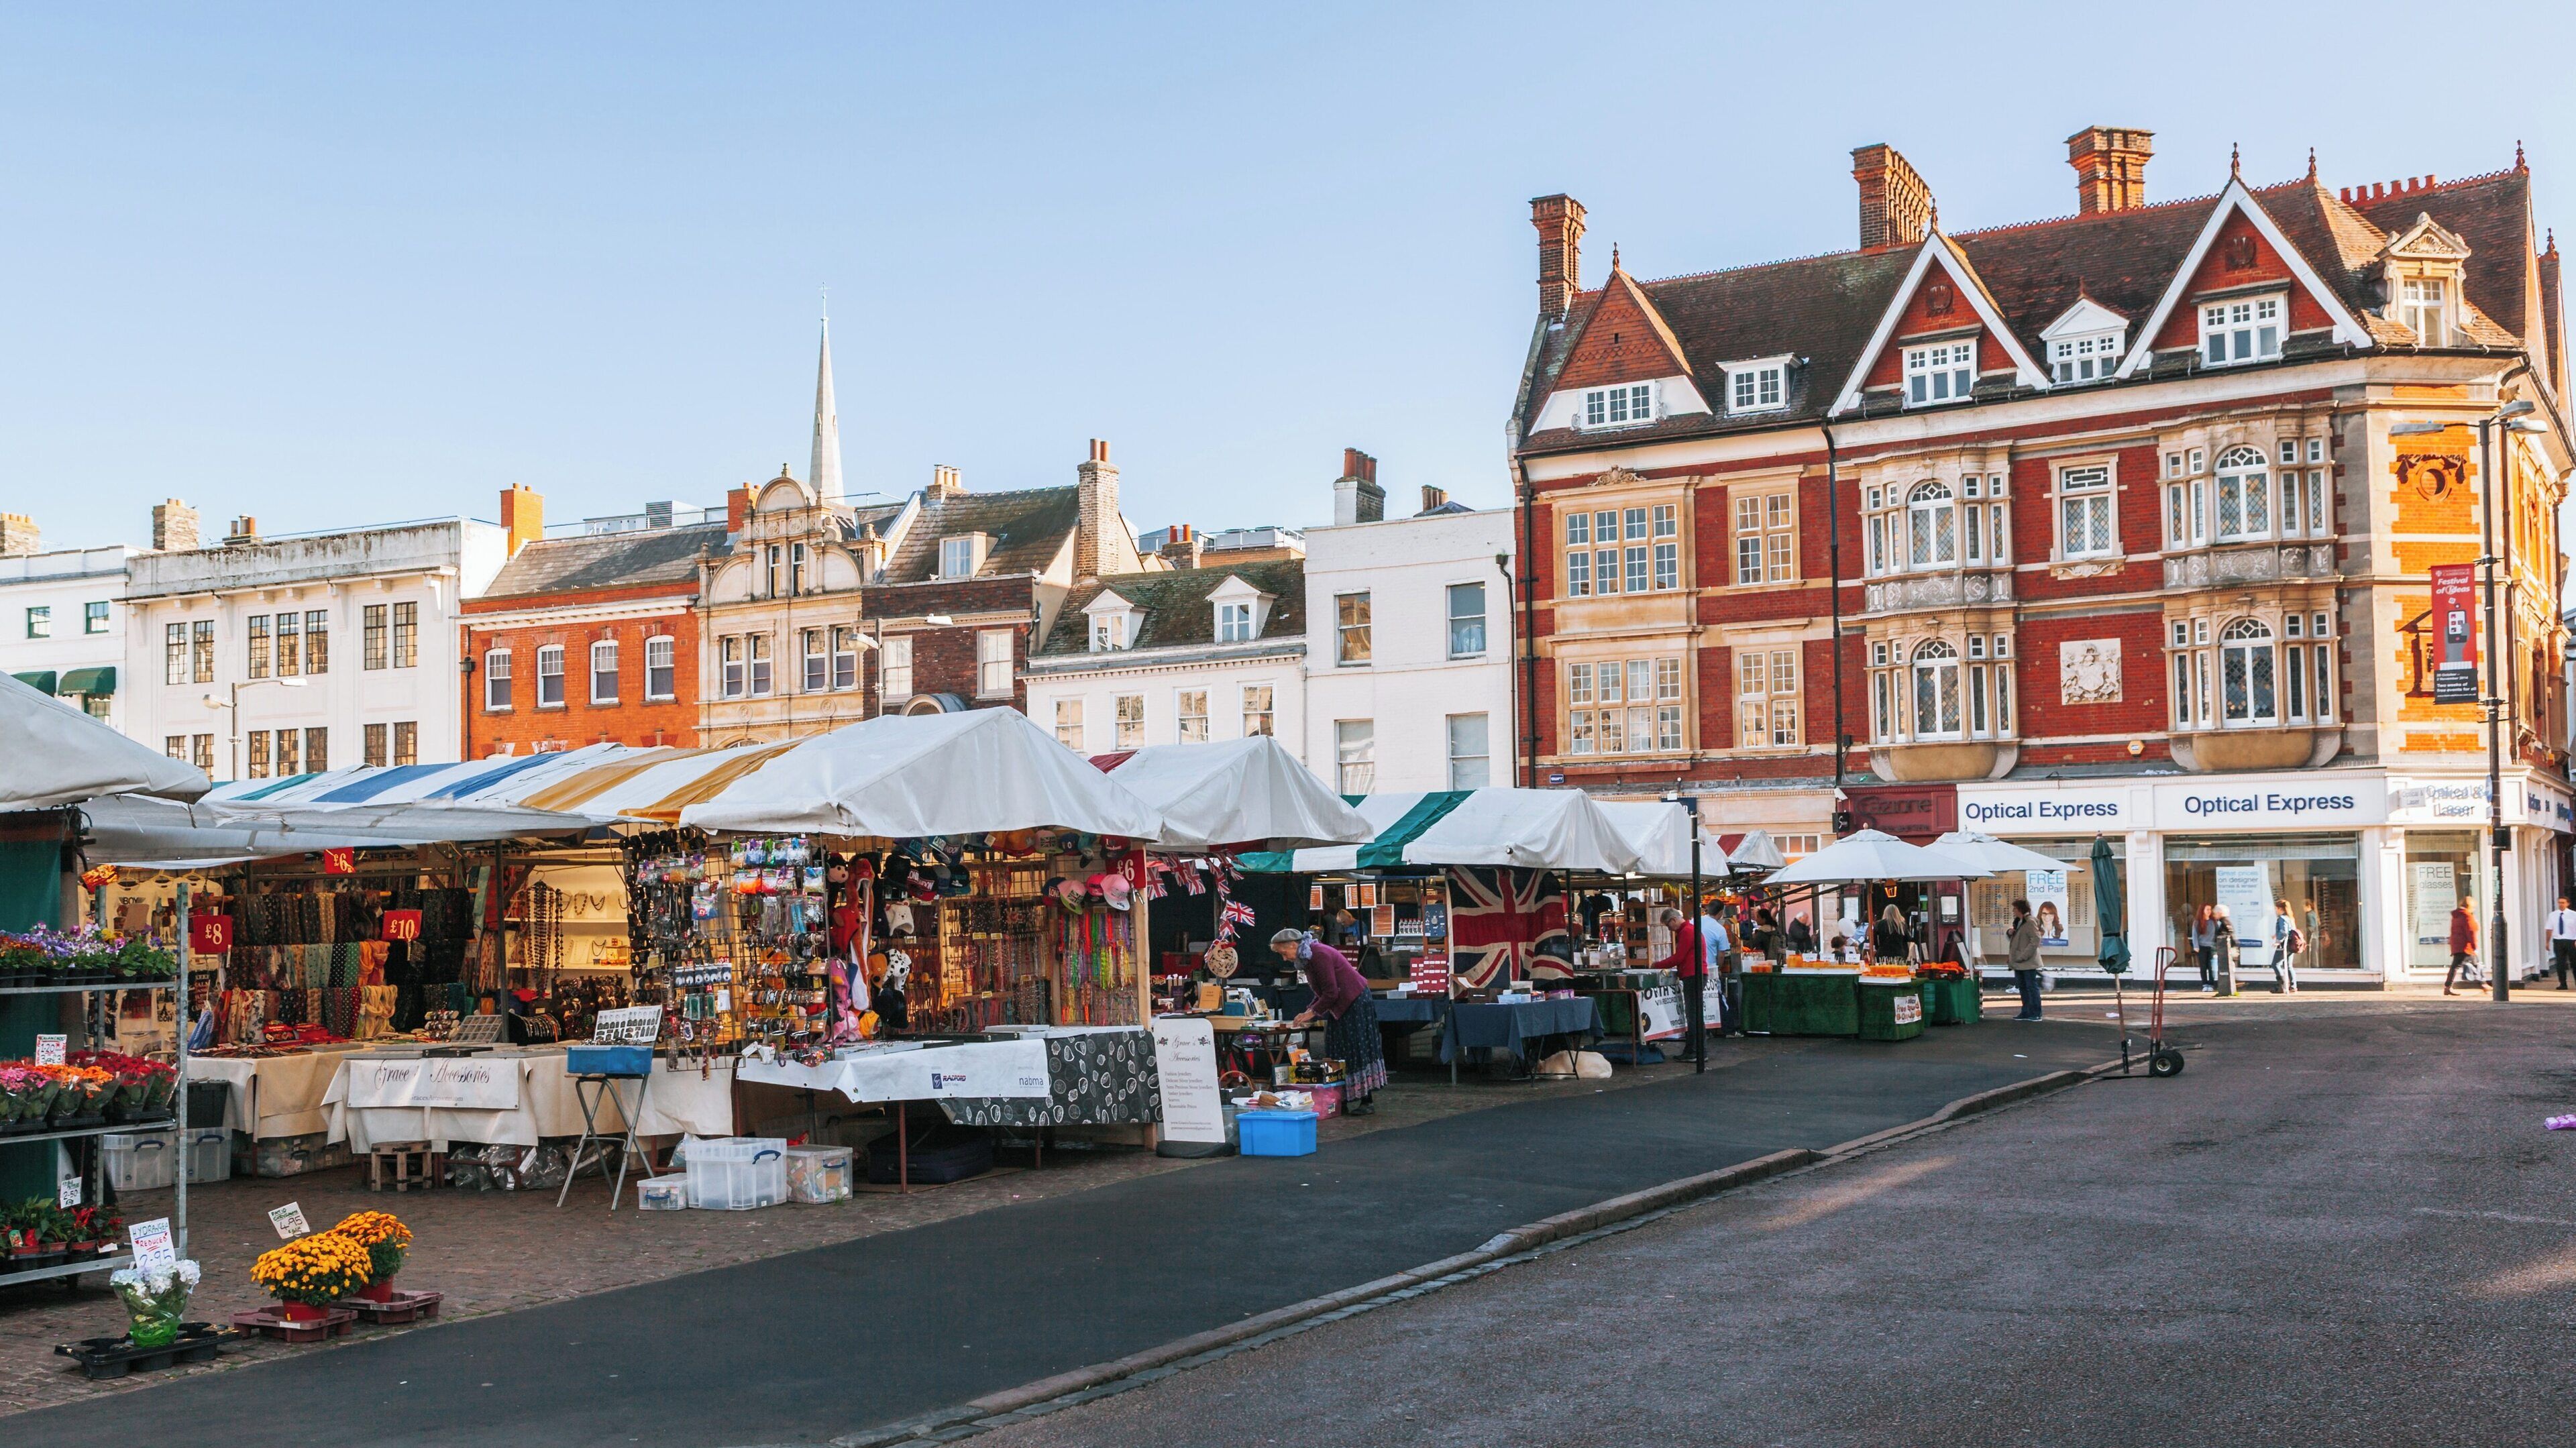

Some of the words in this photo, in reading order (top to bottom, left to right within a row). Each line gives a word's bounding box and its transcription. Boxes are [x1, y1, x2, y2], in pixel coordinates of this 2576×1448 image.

[2437, 577, 2468, 585] Festival
[2447, 586, 2470, 594] Ideas
[1966, 802, 2032, 823] Optical
[2039, 801, 2118, 821] Express
[2185, 794, 2258, 817] Optical
[2267, 793, 2355, 815] Express
[334, 852, 347, 871] £6
[1117, 859, 1135, 881] £6
[2419, 867, 2452, 878] FREE
[2029, 873, 2065, 884] FREE
[2419, 880, 2453, 891] glasses
[123, 897, 138, 905] BOY
[205, 923, 223, 944] £8
[390, 919, 415, 939] £10
[1172, 1035, 1196, 1050] Grace's
[1169, 1051, 1201, 1062] Accessories
[430, 1058, 490, 1084] Accessories
[1019, 1075, 1044, 1086] nabma
[132, 1222, 169, 1237] HYDRANGEA
[280, 1215, 303, 1230] 4.95
[140, 1235, 168, 1247] REDUCED
